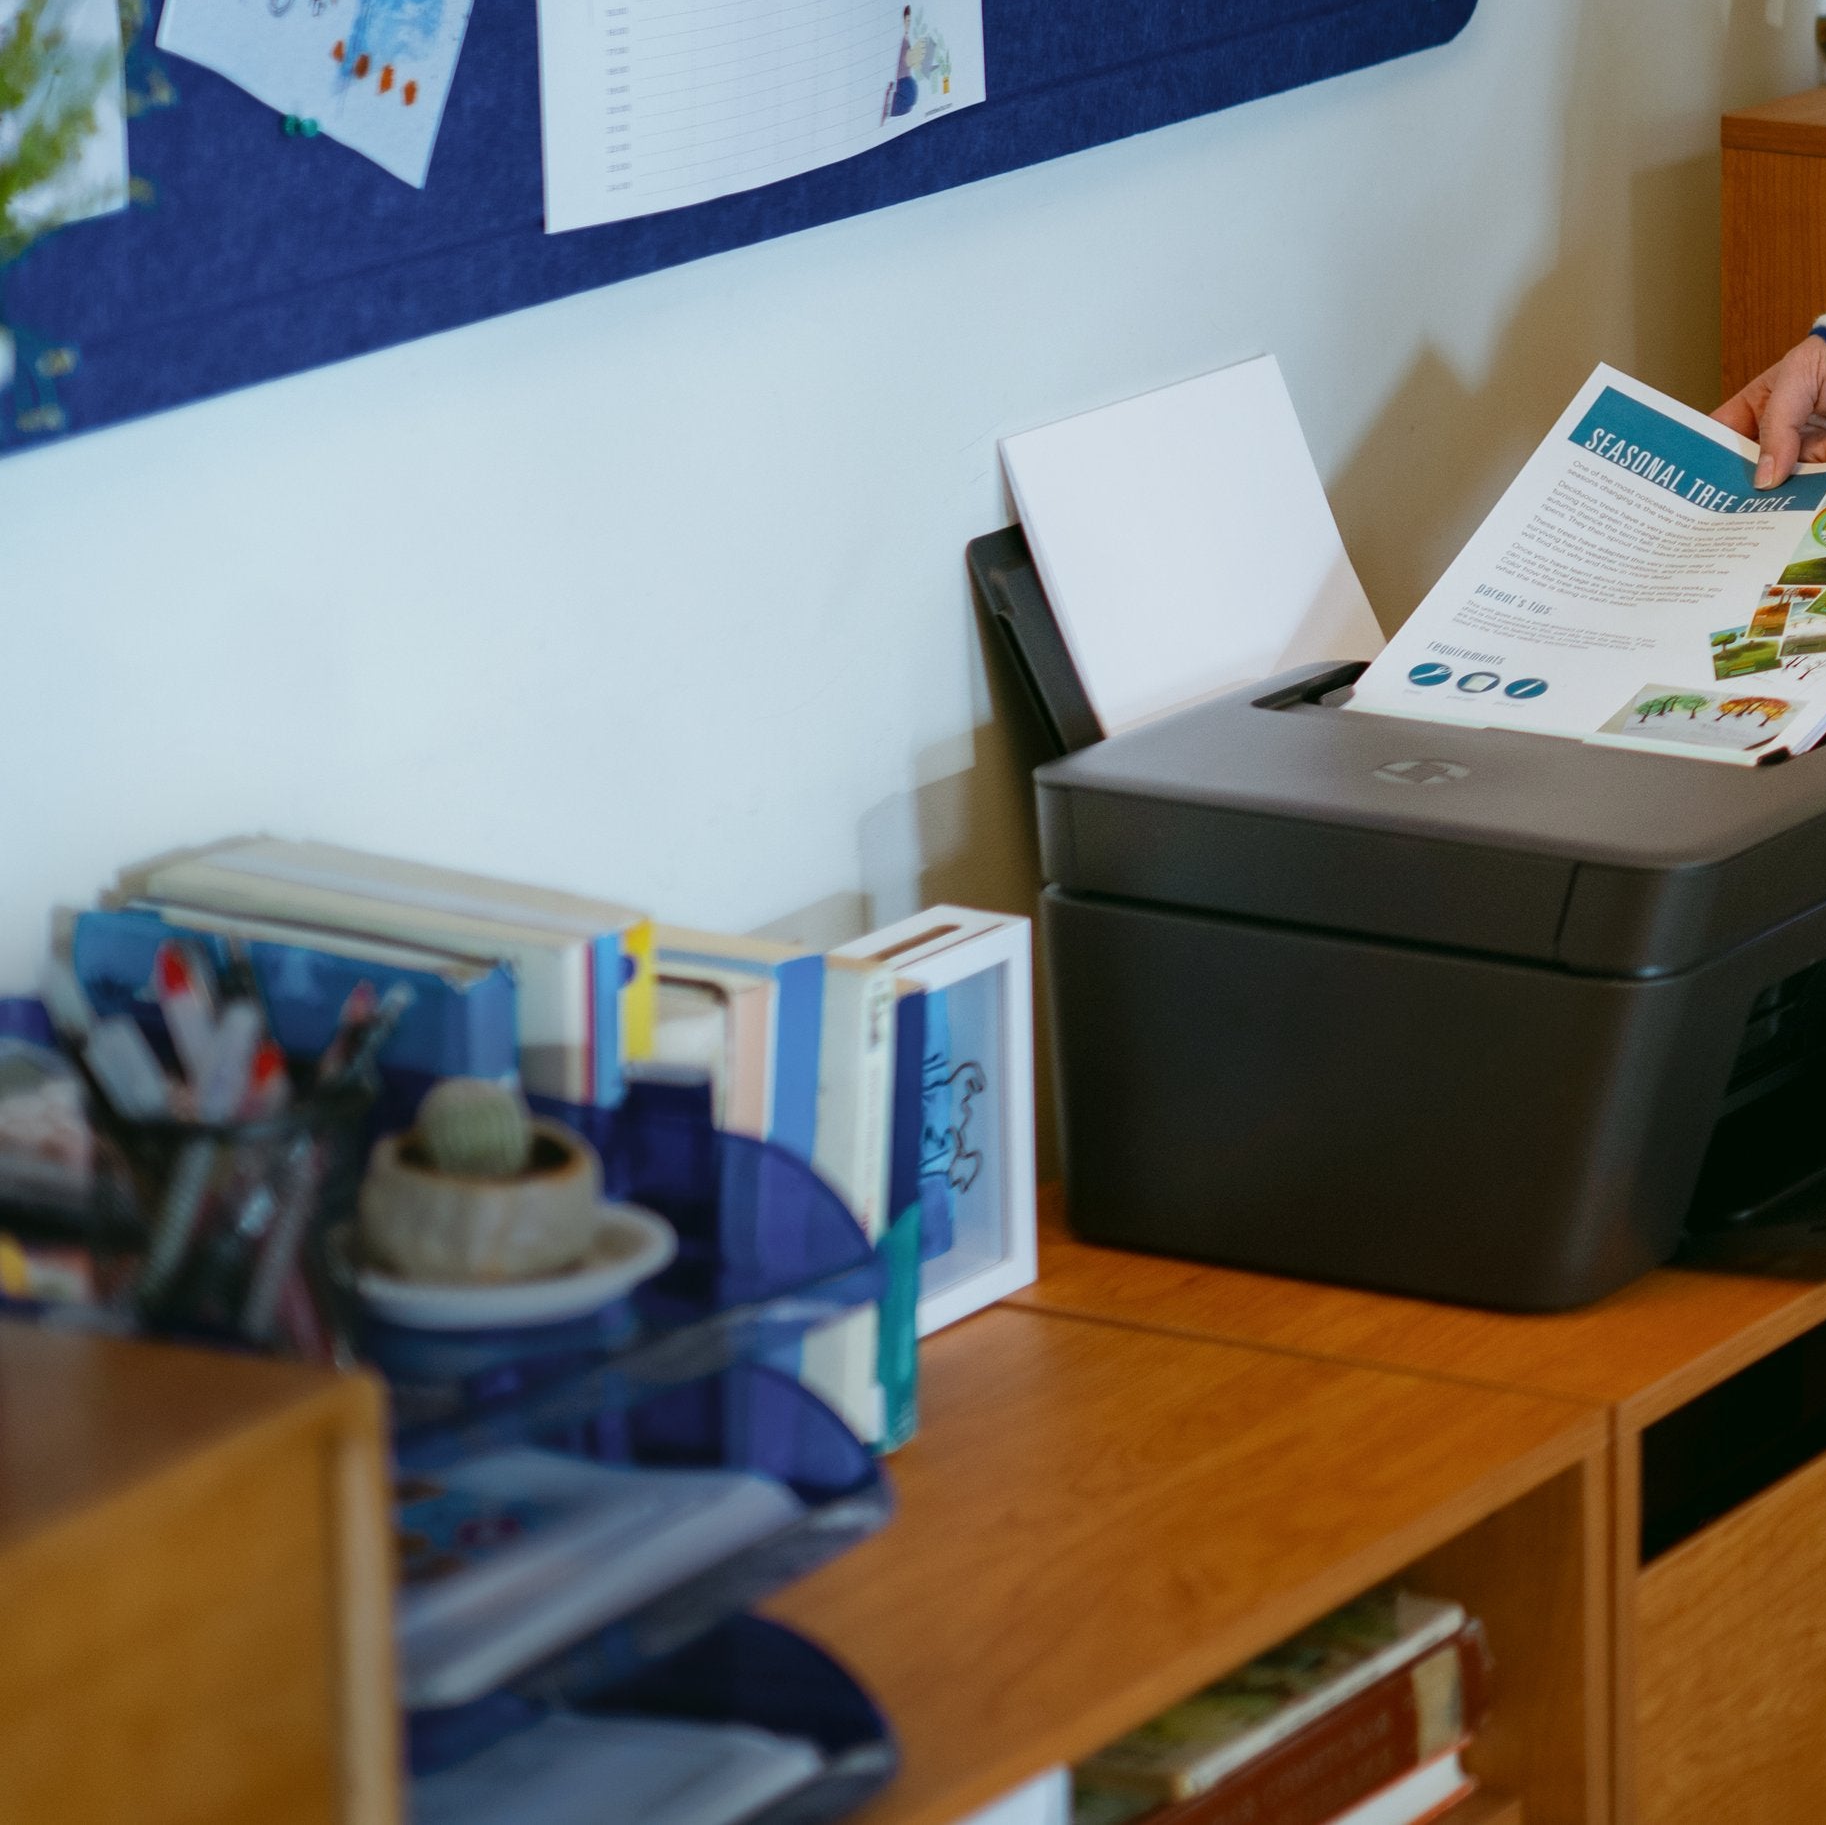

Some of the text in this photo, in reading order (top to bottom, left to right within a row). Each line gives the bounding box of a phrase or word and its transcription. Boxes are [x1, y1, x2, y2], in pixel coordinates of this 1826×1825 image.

[1572, 460, 1588, 471] One
[1584, 427, 1797, 513] SEASONAL TREE CYCLE
[1558, 480, 1597, 504] Deciduous
[1567, 469, 1597, 486] seasons
[1600, 484, 1632, 506] changing
[1553, 487, 1578, 505] turning
[1581, 501, 1598, 514] from
[1546, 496, 1575, 512] autumn
[1576, 509, 1602, 526] (hence
[1534, 513, 1554, 530] These
[1568, 515, 1585, 529] They
[1521, 530, 1535, 539] will
[1527, 523, 1560, 543] surviving
[1512, 541, 1532, 555] Once
[1534, 553, 1548, 562] you
[1522, 557, 1536, 566] use
[1496, 564, 1515, 575] what
[1500, 556, 1521, 569] Color
[1474, 583, 1528, 608] parent's
[1427, 641, 1506, 665] requirements
